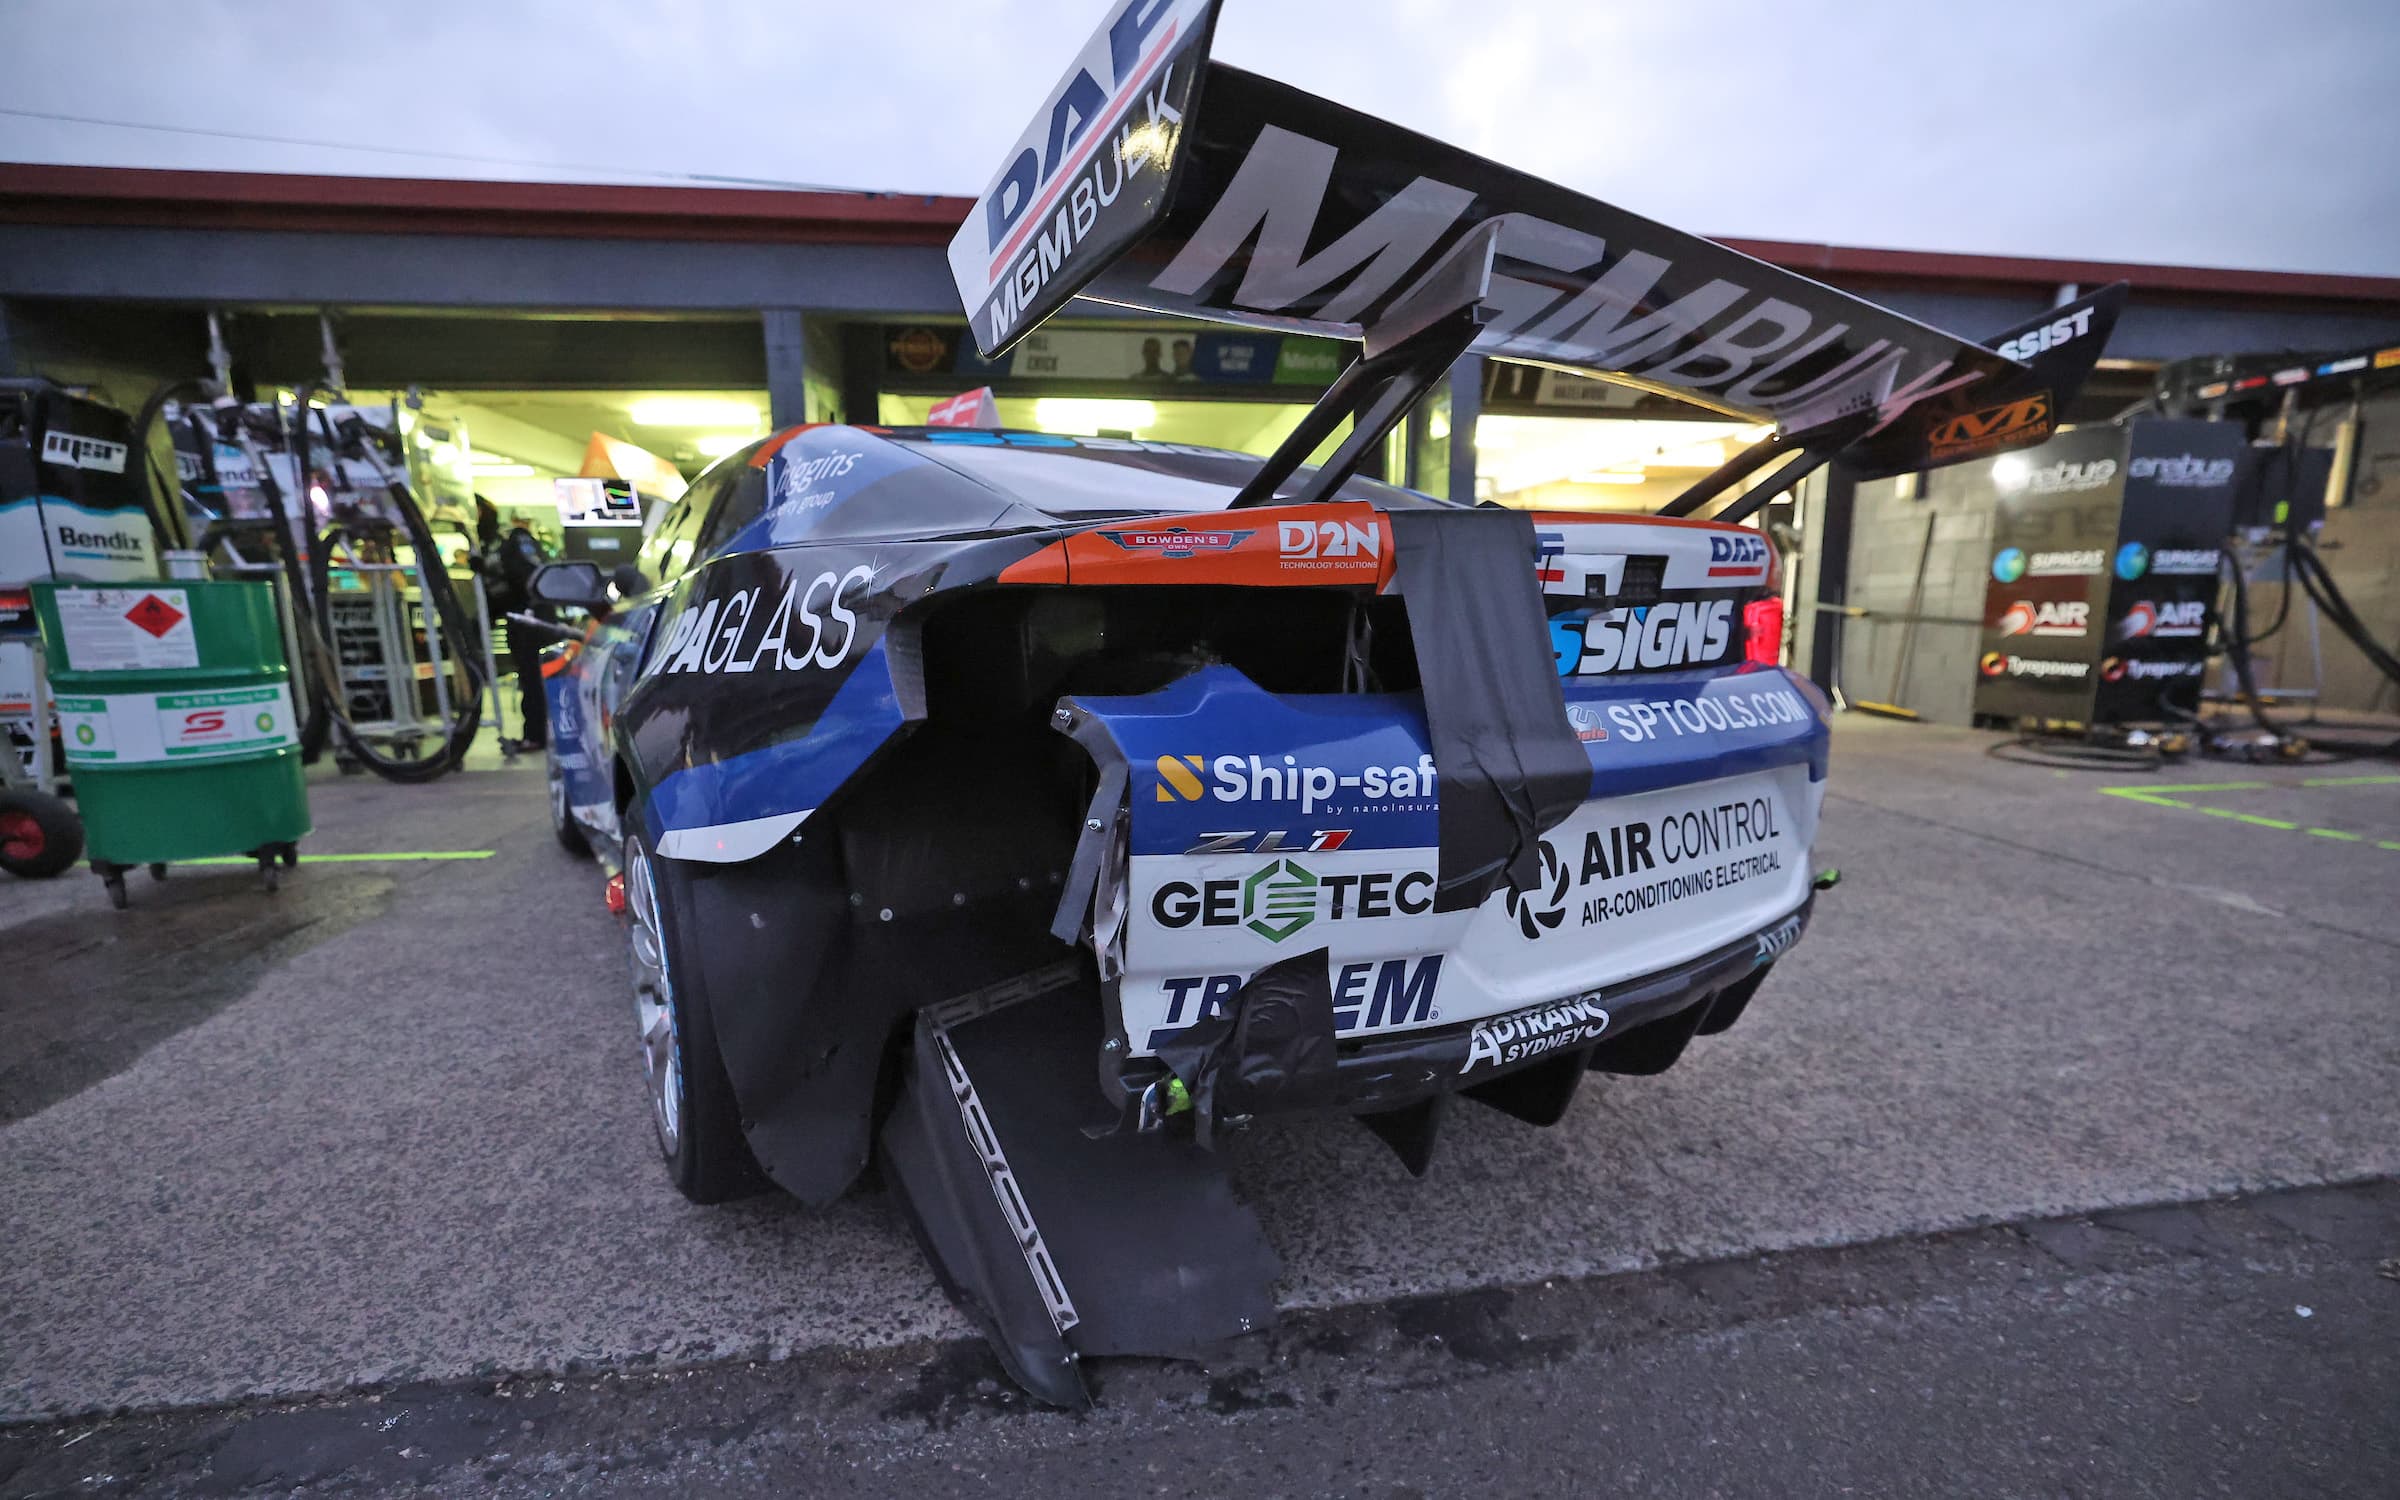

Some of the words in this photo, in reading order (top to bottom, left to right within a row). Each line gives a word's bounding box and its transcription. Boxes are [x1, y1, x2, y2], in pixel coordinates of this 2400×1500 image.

[986, 0, 1176, 256] DAF
[989, 63, 1182, 346] MGMBULK
[58, 526, 143, 551] Bendix
[1135, 535, 1219, 544] BOWDEN'S
[1278, 521, 1379, 559] D2N
[1710, 536, 1767, 563] DAF
[1280, 561, 1332, 569] TECHNOLOGY
[1334, 561, 1378, 569] SOLUTIONS
[2037, 601, 2090, 625] AIR
[2156, 601, 2205, 625] AIR
[1608, 691, 1809, 742] SPTOOLS.COM
[1327, 804, 1343, 816] by
[1184, 829, 1353, 855] ZL1
[1580, 822, 1656, 886] AIR
[1661, 797, 1780, 864] CONTROL
[1582, 867, 1714, 927] AIR-CONDITIONING
[1716, 850, 1781, 887] ELECTRICAL
[1505, 1025, 1587, 1063] SYDNEY
